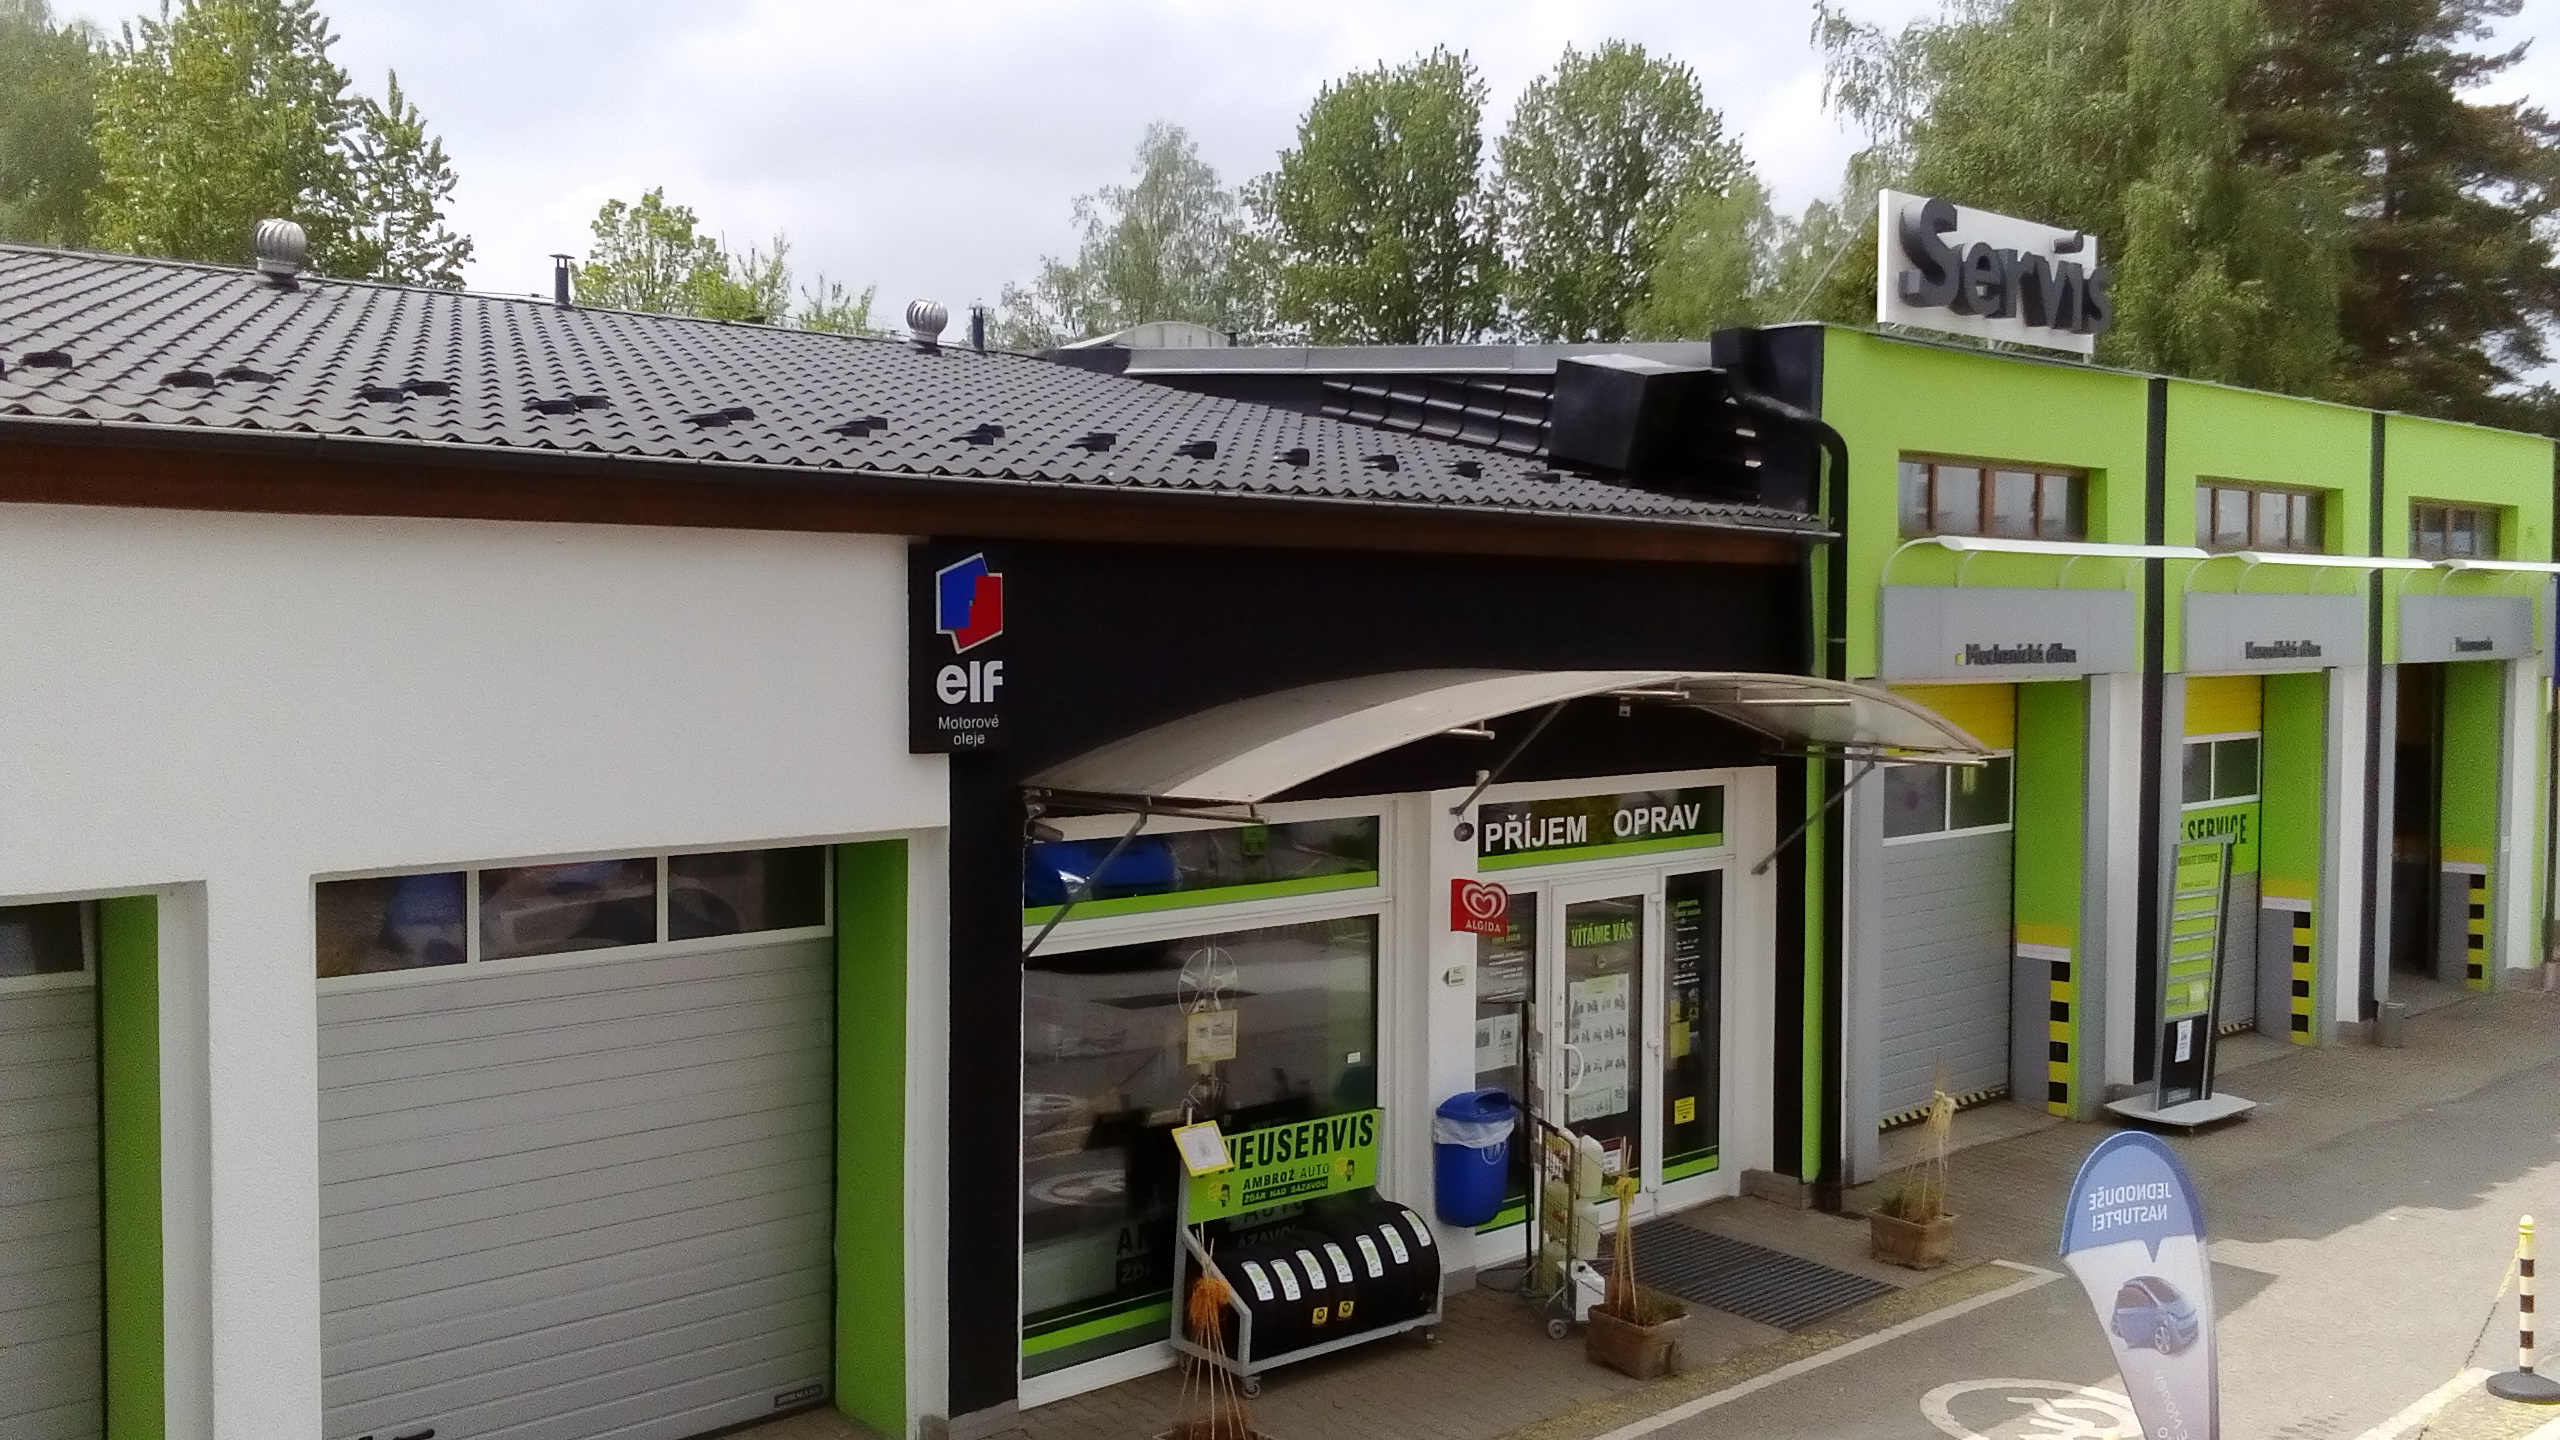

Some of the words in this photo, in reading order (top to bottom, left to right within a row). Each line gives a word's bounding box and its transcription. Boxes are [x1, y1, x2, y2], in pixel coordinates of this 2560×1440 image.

[1898, 196, 2113, 335] Servis
[936, 660, 1004, 704] elf
[938, 714, 999, 730] Motorové
[953, 731, 986, 746] oleje
[1484, 812, 1588, 852] PŘÍJEM
[1612, 803, 1701, 837] OPRAV
[2187, 813, 2247, 845] SERVICE
[1465, 919, 1501, 933] ALGIDA
[1612, 918, 1633, 940] VÁS
[1217, 1113, 1374, 1175] NEUSERVIS
[1243, 1167, 1295, 1190] AMBROŽ
[1300, 1163, 1330, 1179] AUTO
